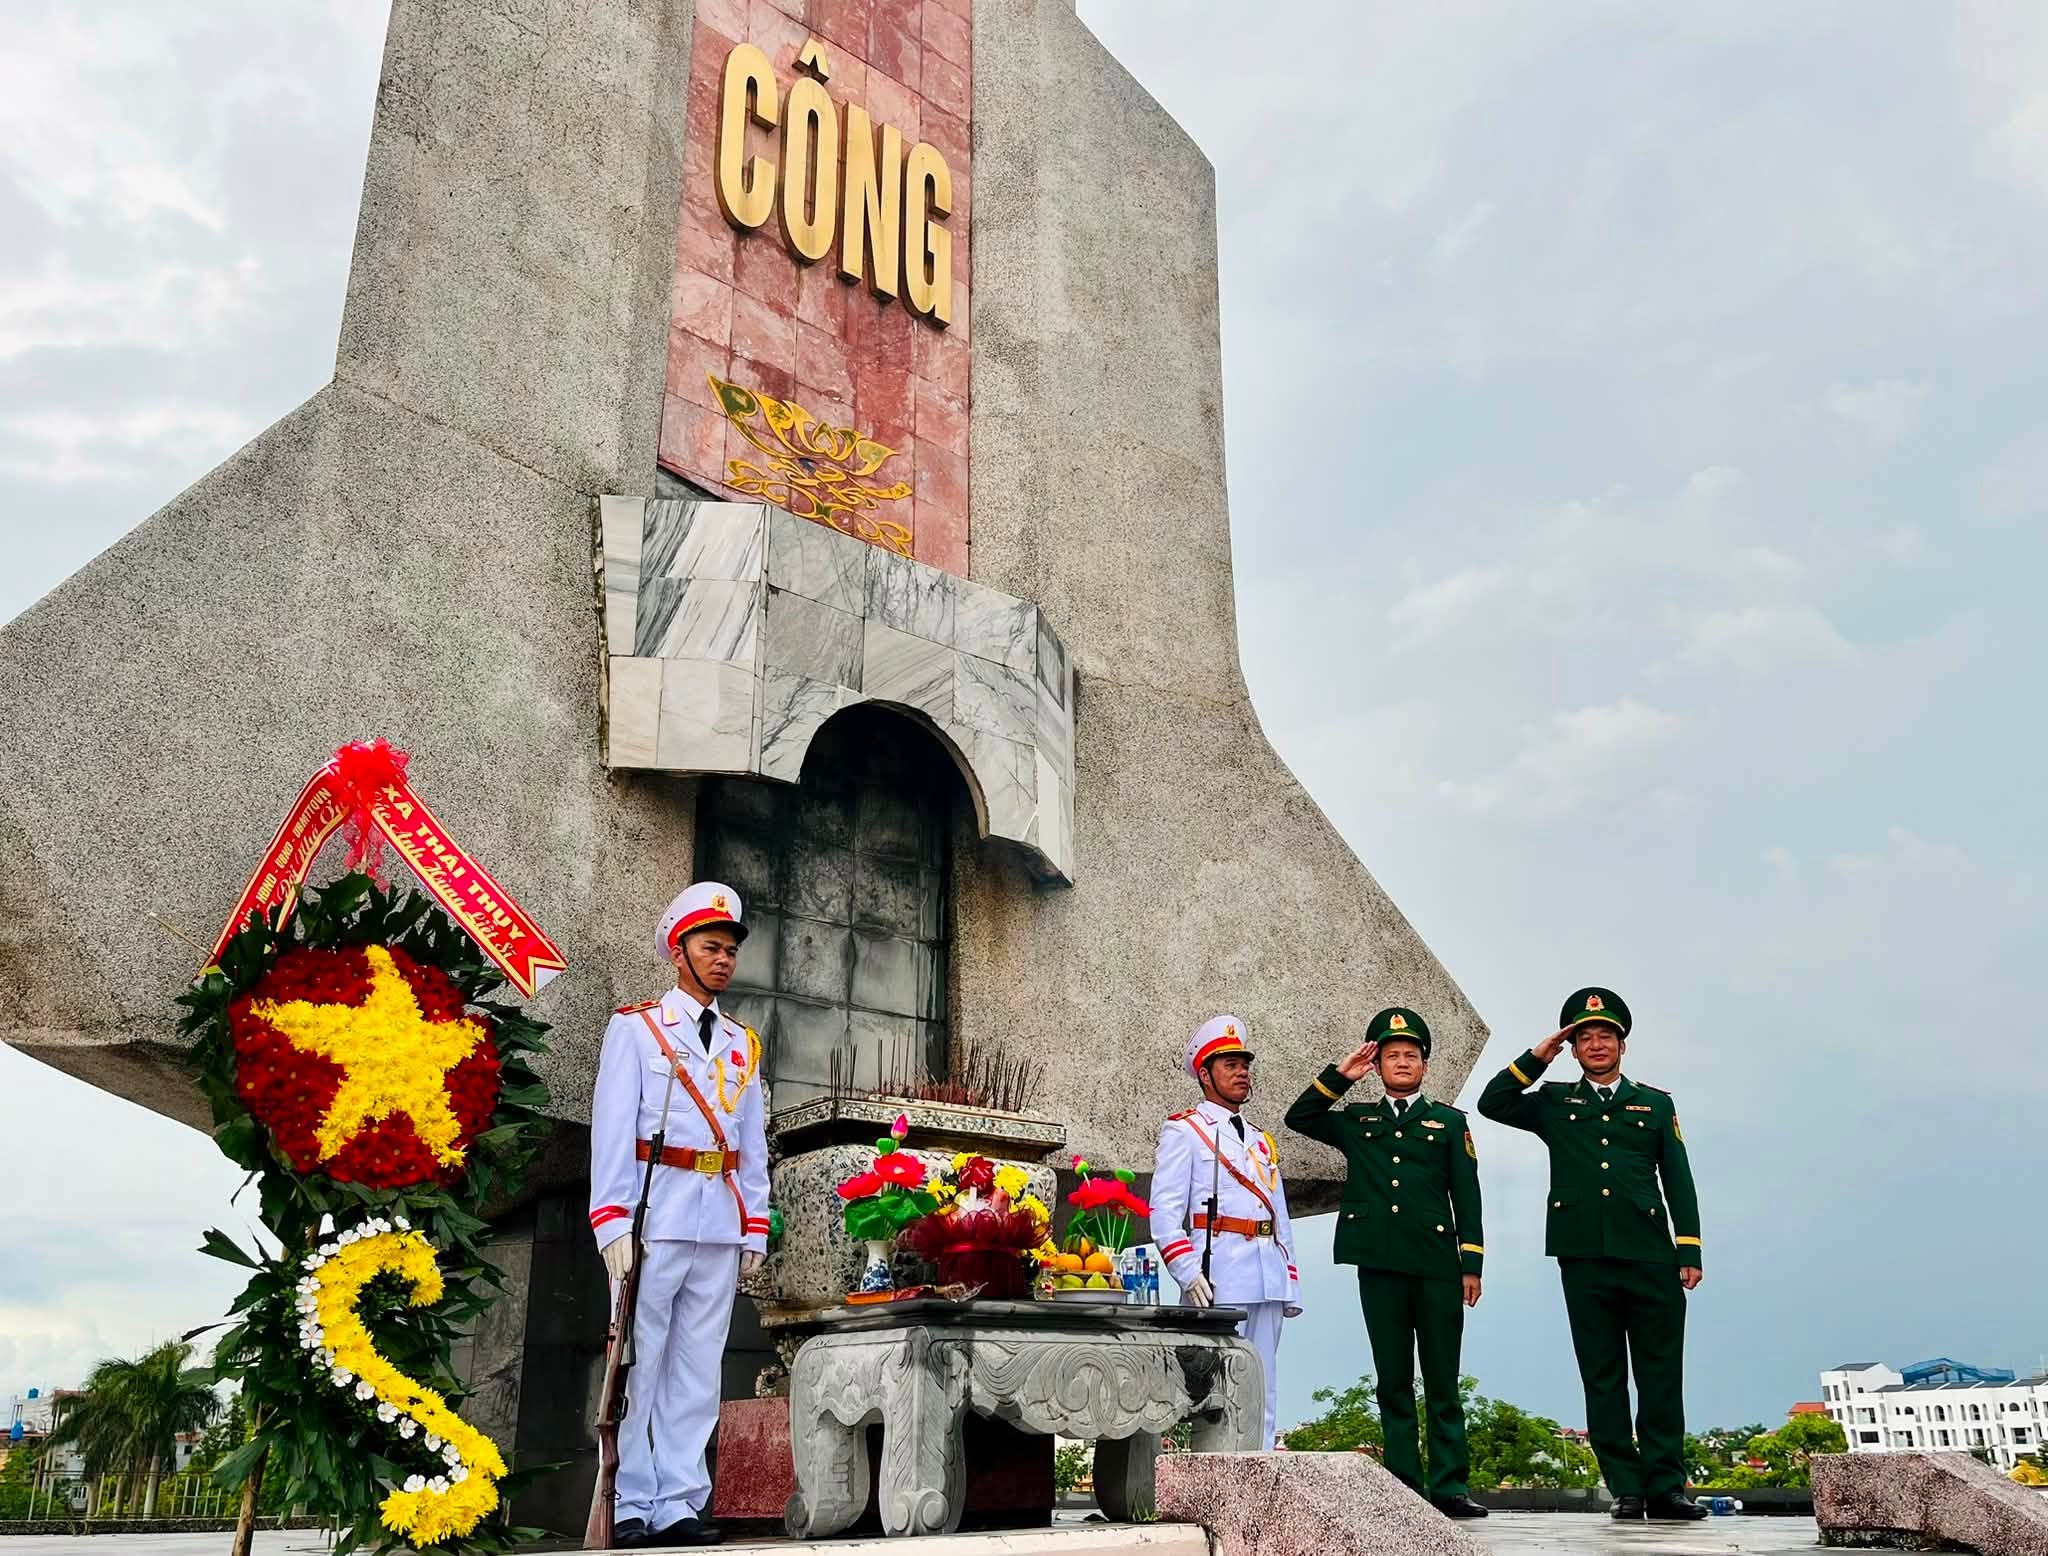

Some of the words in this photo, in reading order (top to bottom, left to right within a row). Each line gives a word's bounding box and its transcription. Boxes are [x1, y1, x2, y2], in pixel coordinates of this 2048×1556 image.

[714, 38, 952, 329] CÔNG
[381, 783, 415, 820] XÃ
[416, 822, 466, 878] THÁI
[467, 880, 526, 940] THỤY
[390, 824, 426, 859] Anh
[424, 860, 466, 908] Hùng
[465, 911, 499, 940] Liệt
[495, 942, 517, 958] Sĩ
